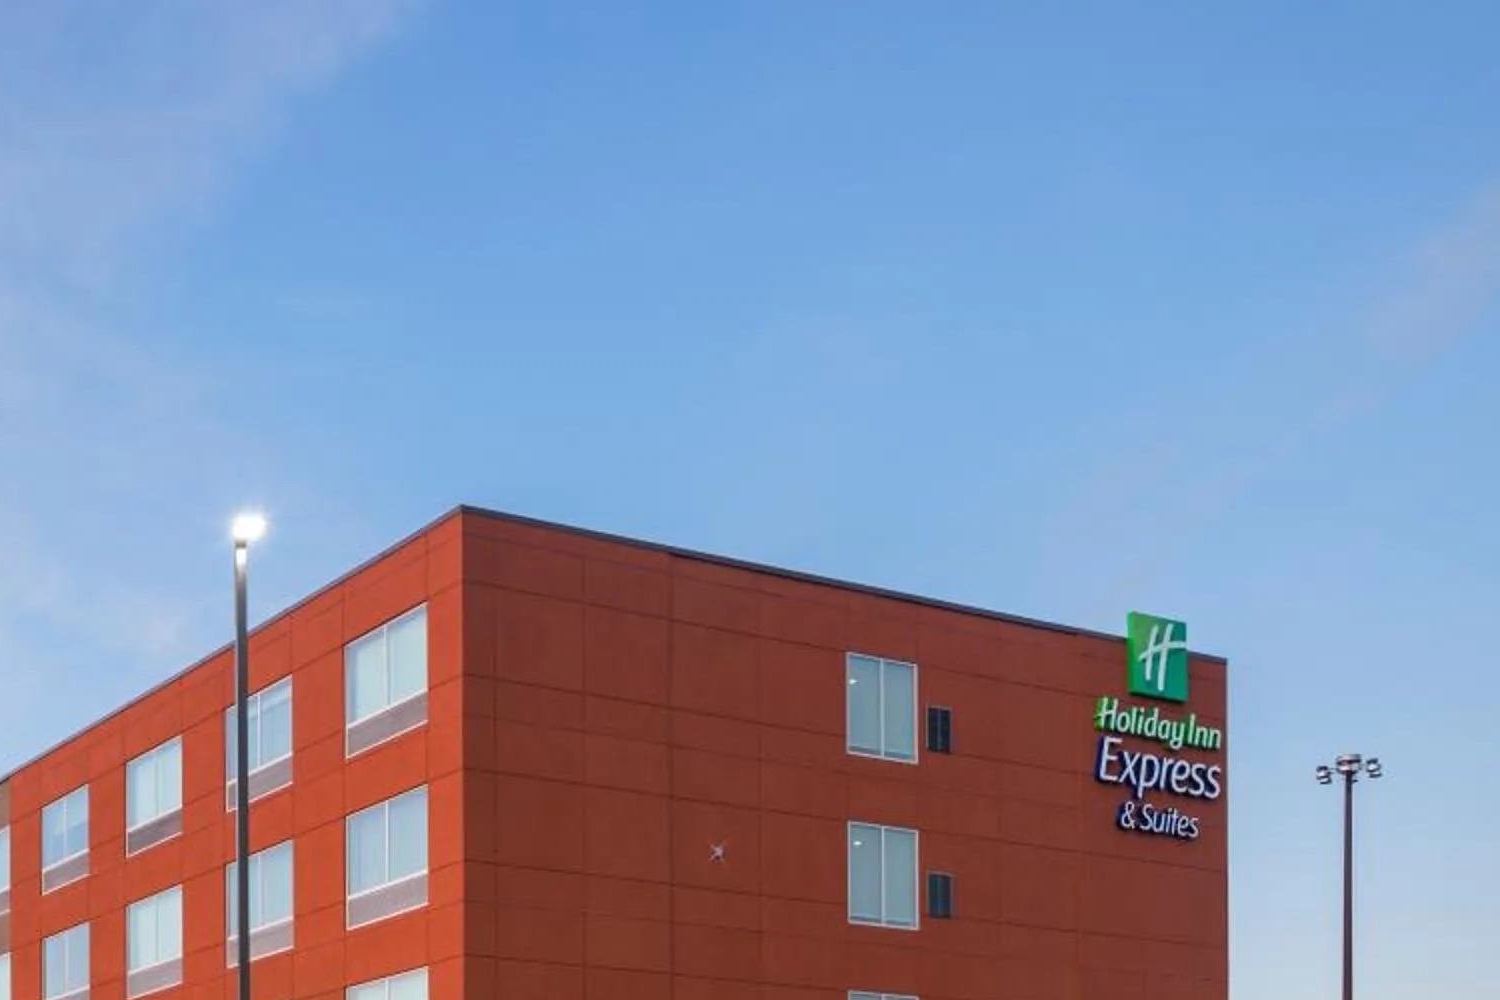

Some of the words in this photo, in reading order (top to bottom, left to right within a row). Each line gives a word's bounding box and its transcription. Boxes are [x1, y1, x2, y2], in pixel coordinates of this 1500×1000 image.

[1098, 697, 1183, 750] Holiday
[1188, 713, 1221, 749] Inn
[1100, 736, 1221, 799] Express
[1121, 801, 1136, 830] &
[1140, 804, 1199, 838] Suites
